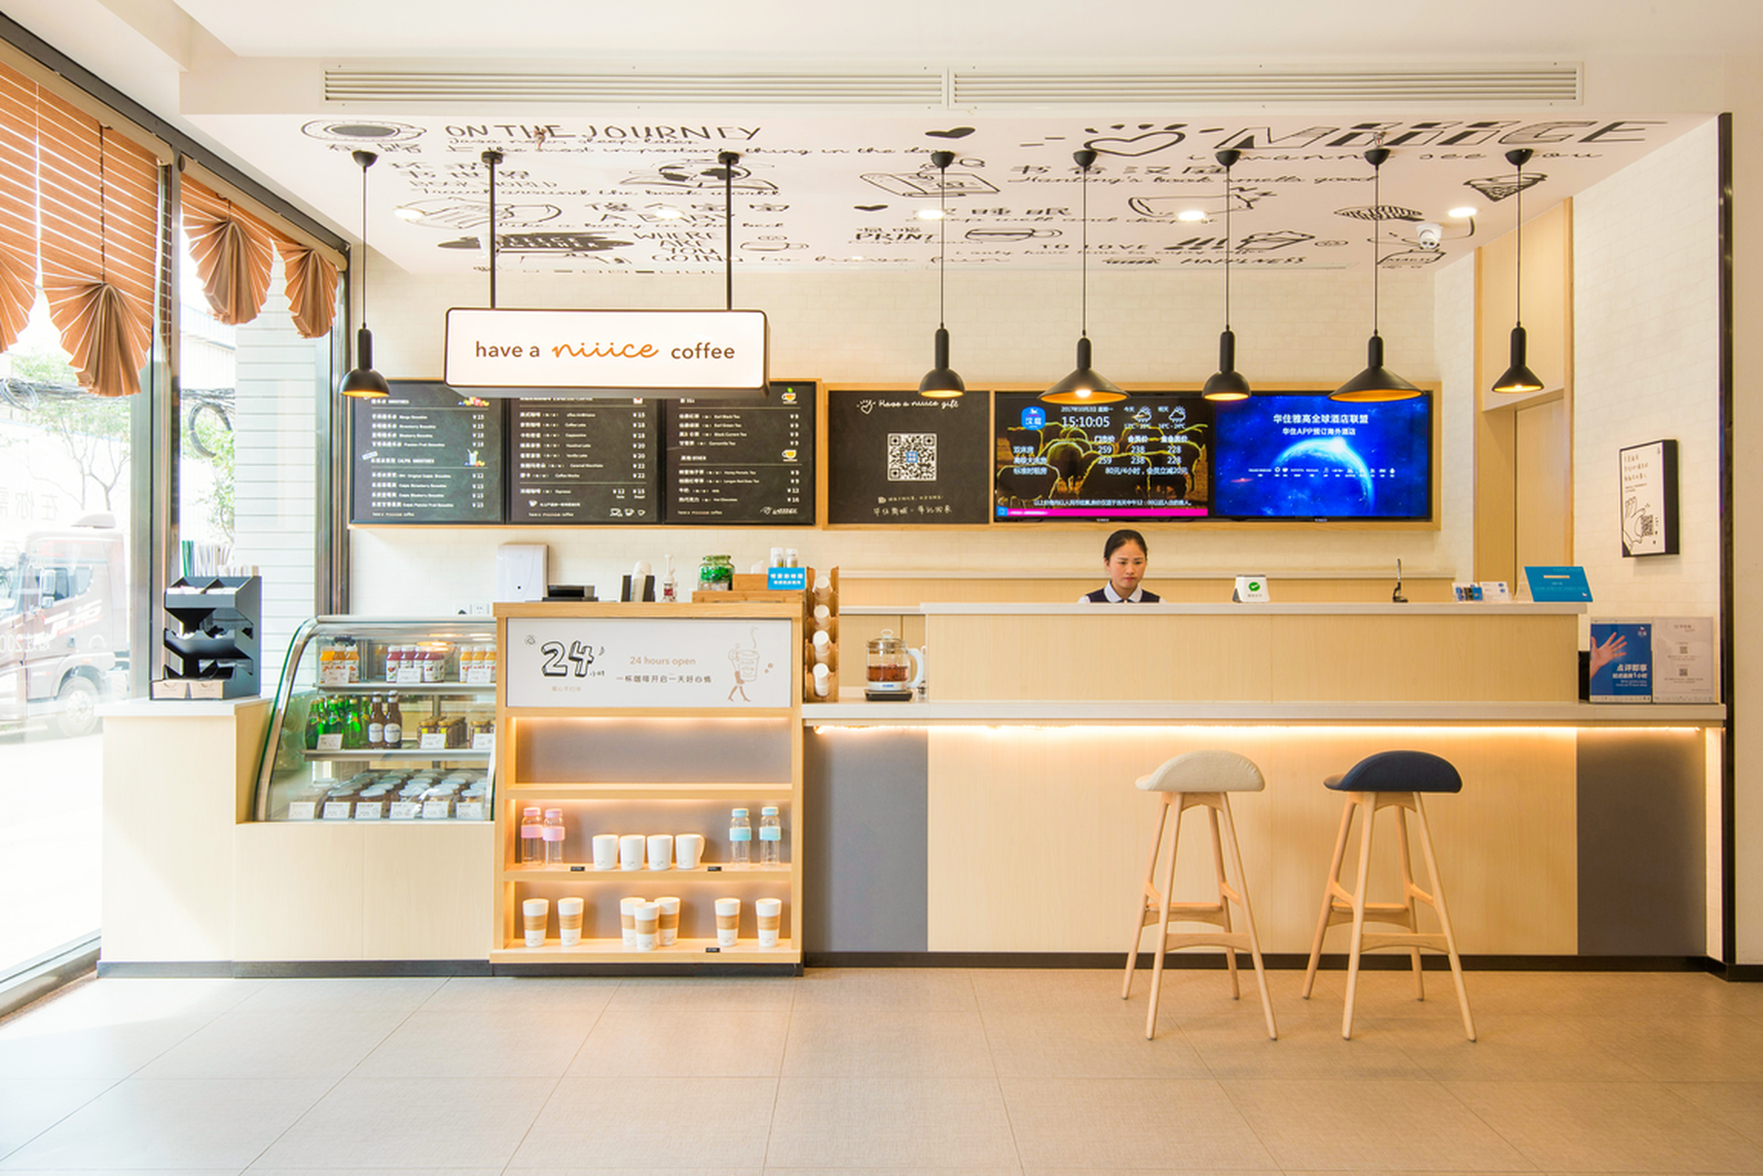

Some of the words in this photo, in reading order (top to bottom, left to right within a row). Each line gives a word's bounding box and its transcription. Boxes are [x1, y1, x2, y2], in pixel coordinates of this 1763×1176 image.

[582, 125, 760, 140] JOURNEY
[1153, 175, 1213, 183] book
[634, 232, 718, 240] WHERE
[856, 233, 938, 241] PRINT
[476, 341, 523, 357] have
[529, 346, 540, 357] a
[552, 341, 659, 358] niiice
[671, 342, 735, 359] coffee
[941, 400, 959, 410] gift
[1061, 415, 1110, 428] 15:10:05
[1273, 414, 1368, 424] 华住雅高全球酒店联盟
[541, 640, 594, 678] 24
[630, 656, 641, 665] 24
[644, 656, 670, 665] hours
[671, 658, 696, 667] open
